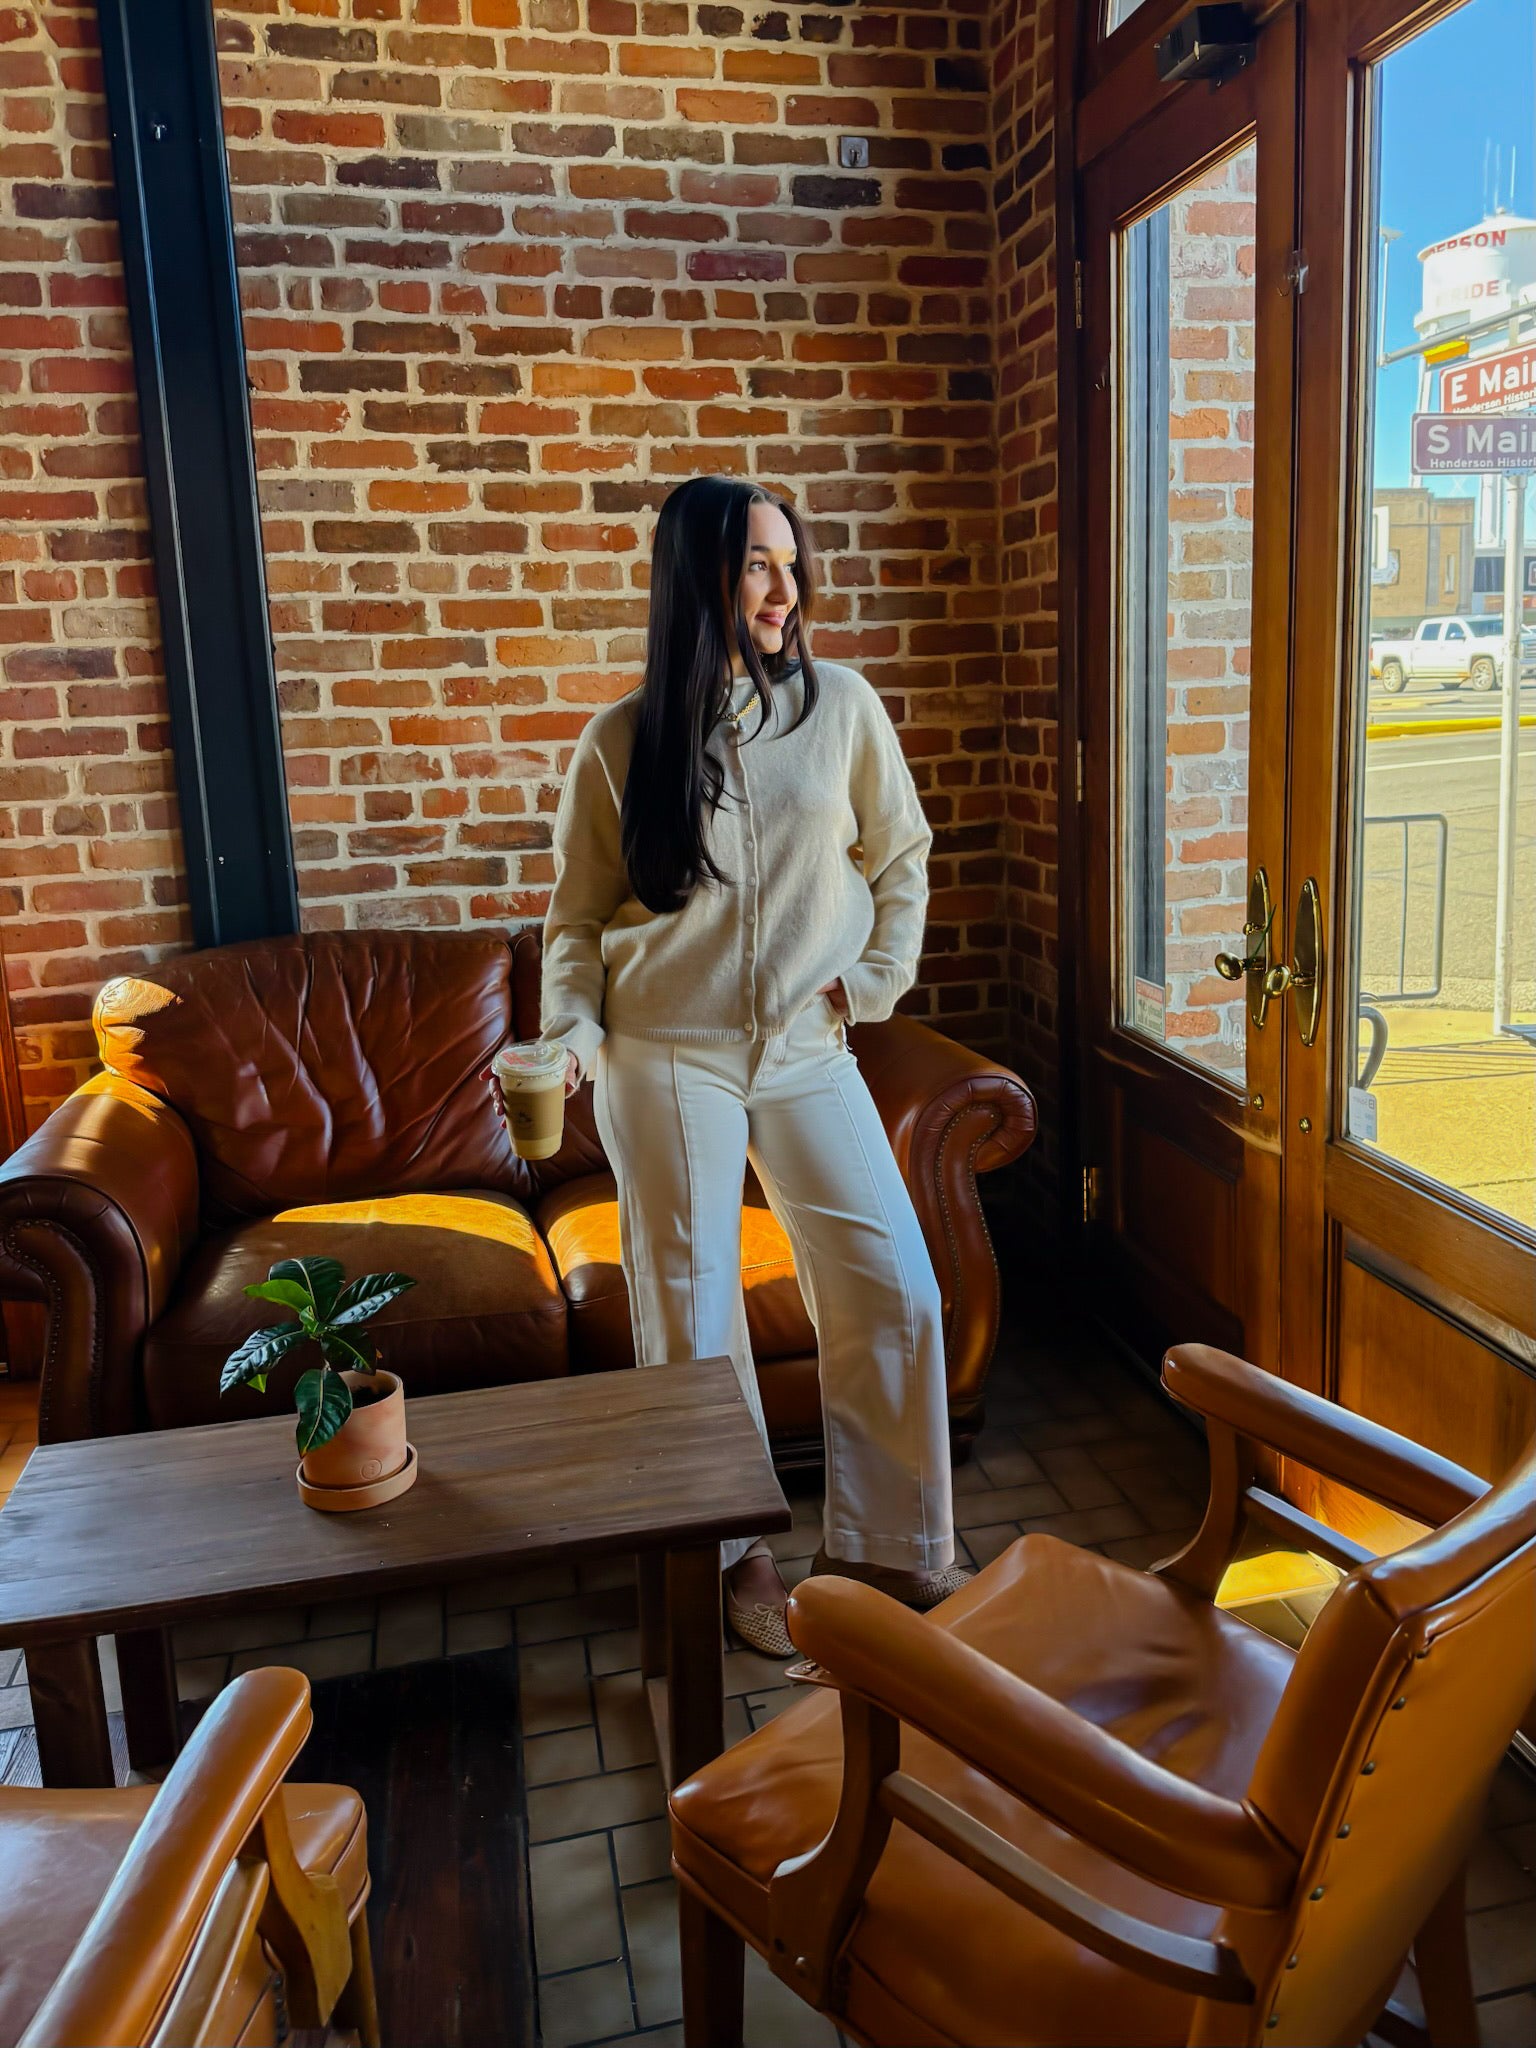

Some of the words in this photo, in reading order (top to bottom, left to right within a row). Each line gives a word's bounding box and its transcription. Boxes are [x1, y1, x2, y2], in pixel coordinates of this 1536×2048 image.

[1452, 373, 1468, 404] E
[1427, 424, 1450, 454] S
[1430, 458, 1493, 468] Henderson
